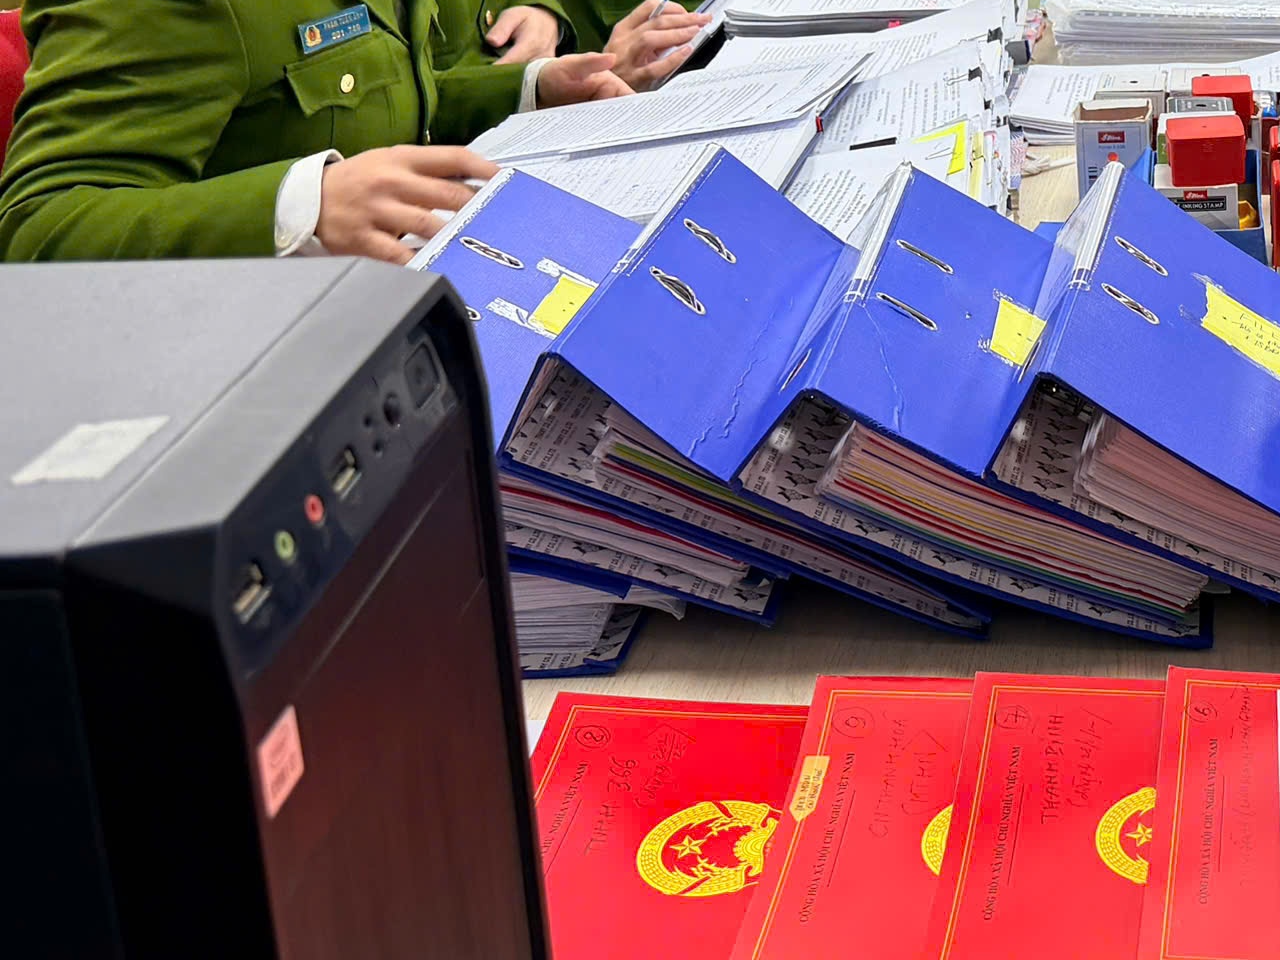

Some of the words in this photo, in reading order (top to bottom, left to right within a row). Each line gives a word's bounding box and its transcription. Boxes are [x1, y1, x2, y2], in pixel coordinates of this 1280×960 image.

[842, 751, 855, 773] NAM
[1009, 745, 1021, 767] NAM
[834, 774, 850, 796] VIỆT
[1004, 768, 1019, 791] VIỆT
[825, 796, 843, 825] NGHĨA
[998, 791, 1014, 821] NGHĨA
[819, 827, 834, 845] CHỦ
[995, 821, 1009, 841] CHỦ
[815, 843, 830, 863] HỘI
[992, 842, 1006, 860] HỘI
[811, 862, 825, 876] XÃ
[990, 859, 1002, 873] XÃ
[805, 875, 821, 897] HÒA
[987, 874, 1000, 894] HÒA
[797, 896, 814, 924] CỘNG
[981, 895, 997, 921] CỘNG
